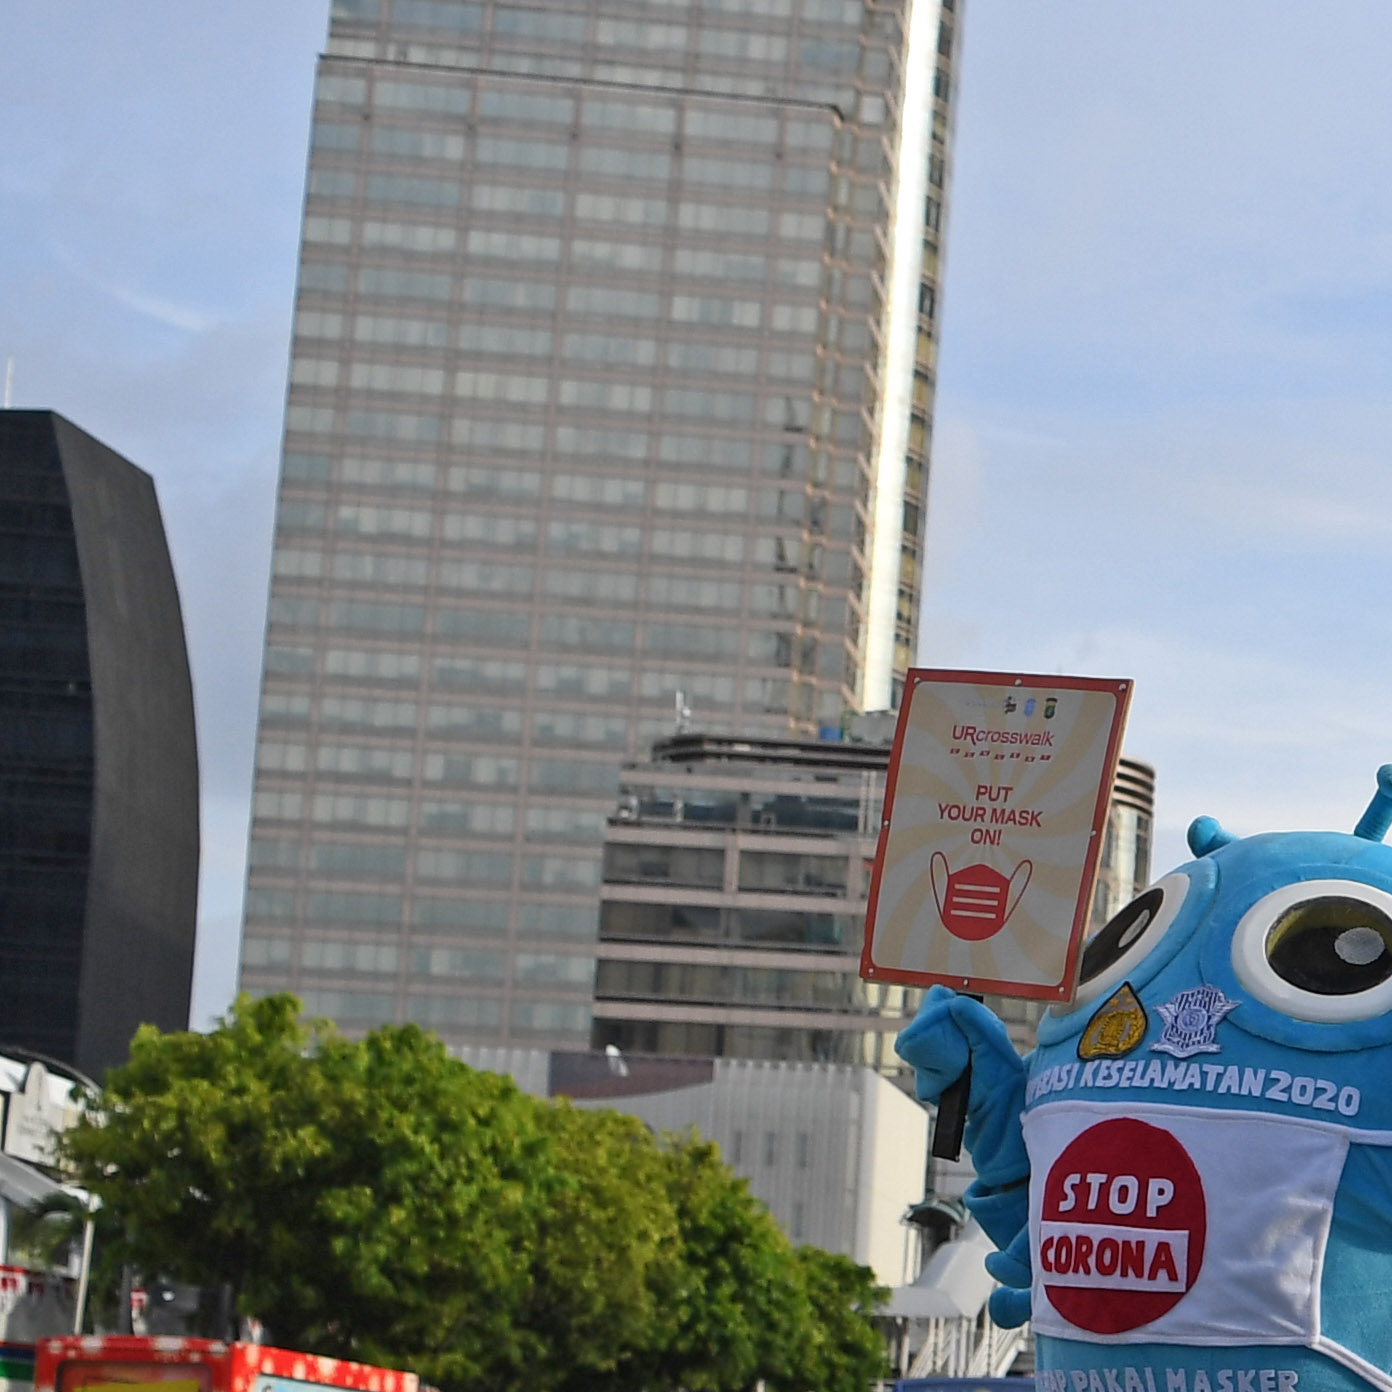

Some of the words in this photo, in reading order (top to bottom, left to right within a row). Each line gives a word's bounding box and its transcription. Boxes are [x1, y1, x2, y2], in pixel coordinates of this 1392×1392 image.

[952, 724, 1054, 747] URcrosswalk
[975, 784, 1013, 803] PUT
[938, 802, 986, 823] YOUR
[989, 807, 1043, 828] MASK
[970, 828, 1002, 846] ON!
[1081, 1059, 1263, 1098] KESELAMATAN
[1264, 1070, 1361, 1116] 2020
[1058, 1172, 1176, 1218] STOP
[1040, 1235, 1178, 1283] CORONA
